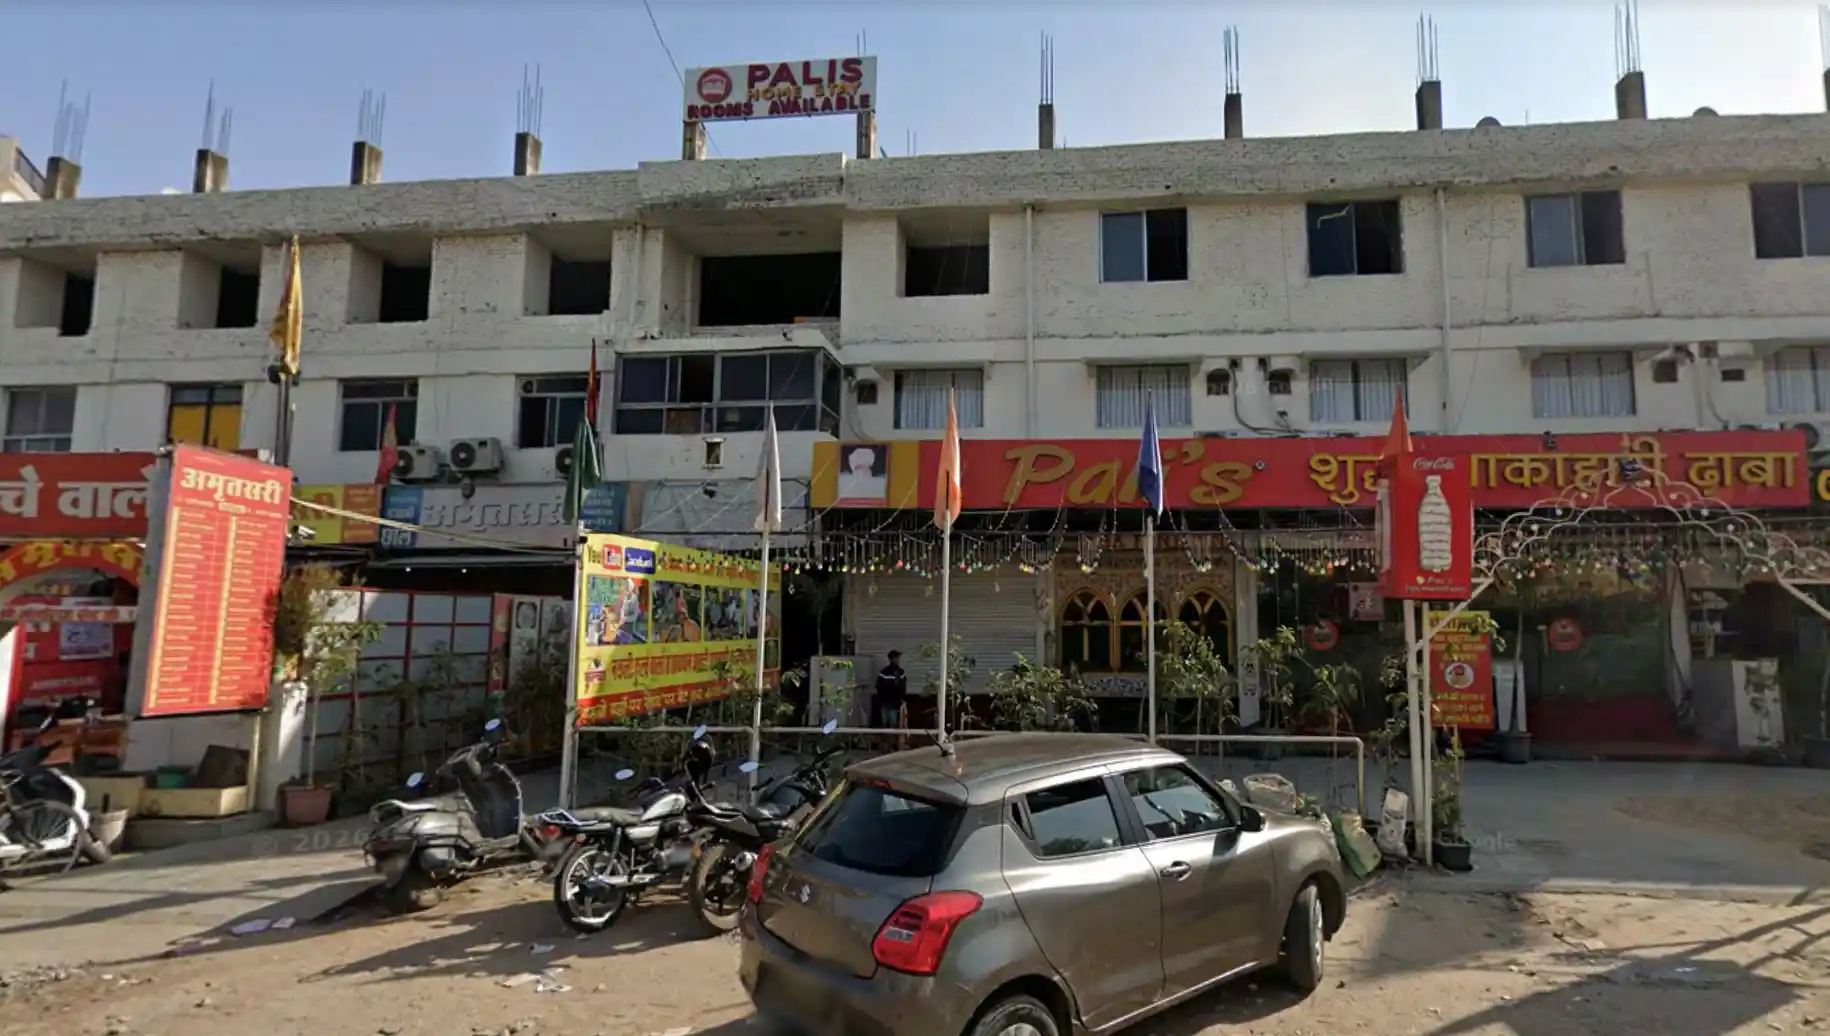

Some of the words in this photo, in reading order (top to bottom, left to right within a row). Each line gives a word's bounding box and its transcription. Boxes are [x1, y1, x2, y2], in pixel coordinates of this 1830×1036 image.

[747, 57, 864, 89] PALIS
[748, 83, 802, 102] HOME
[815, 79, 862, 98] STAY
[687, 101, 754, 119] ROOMS
[768, 94, 870, 116] AVAILABLE
[180, 466, 284, 505] अमृतसरी
